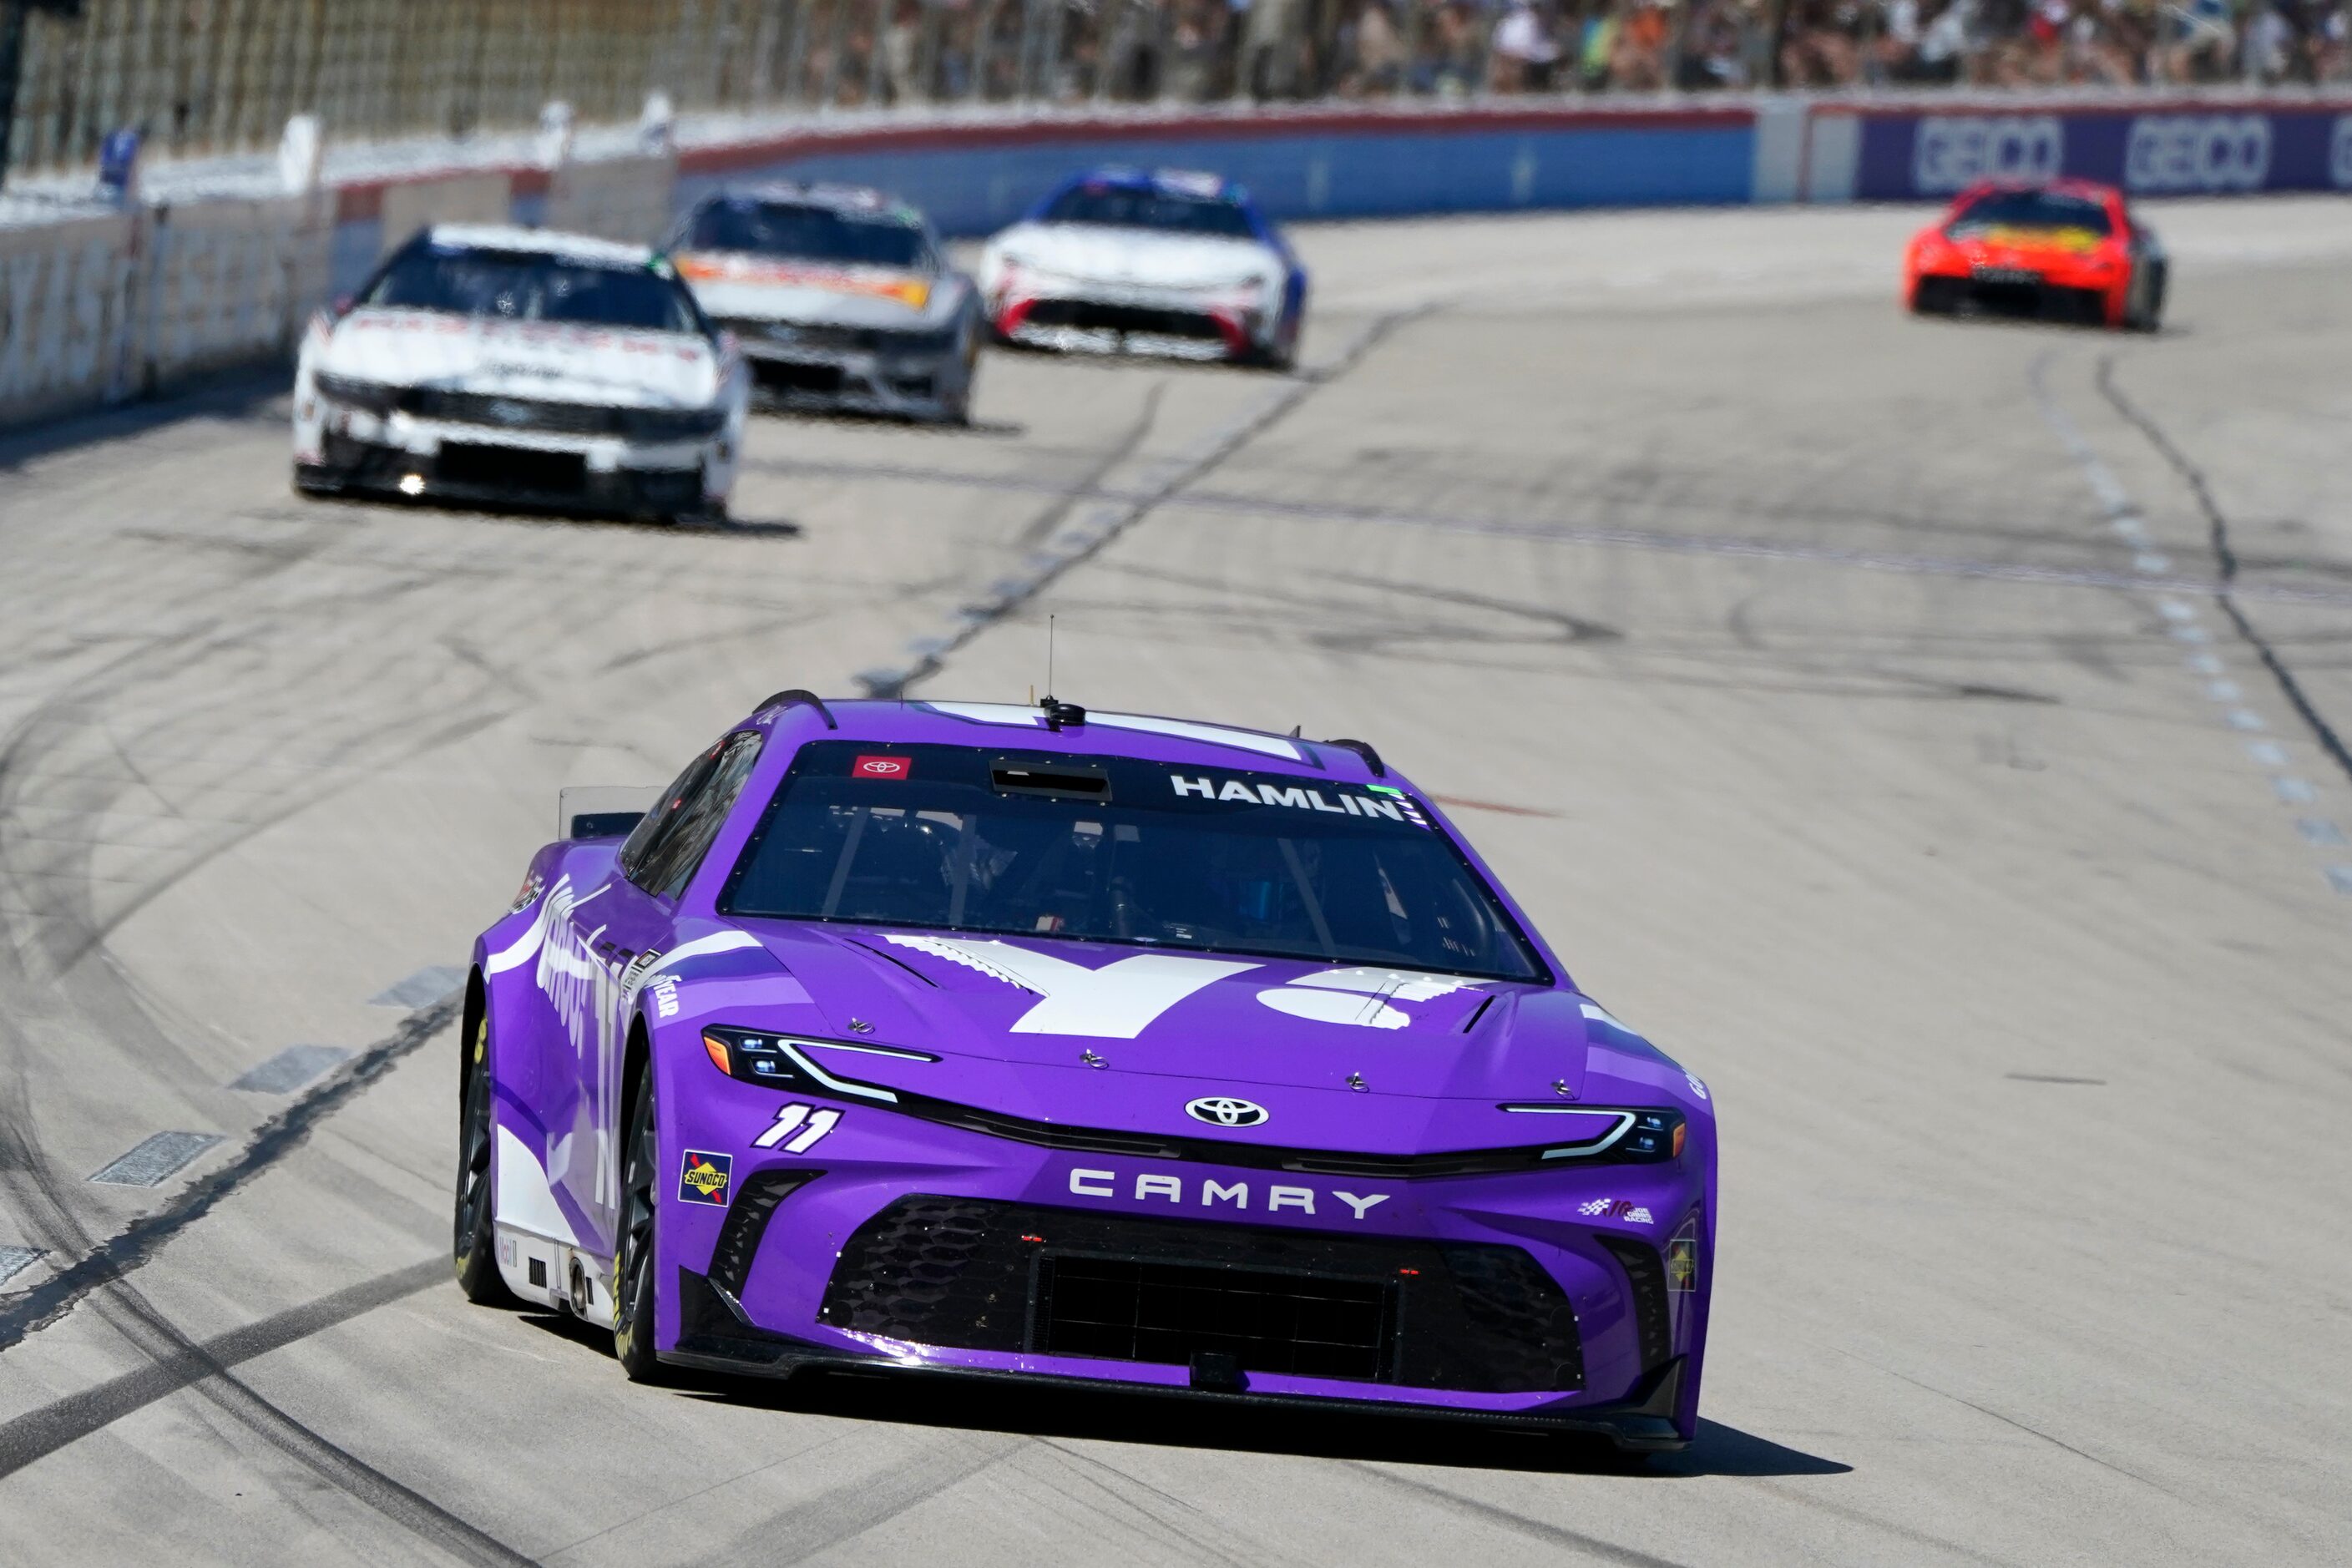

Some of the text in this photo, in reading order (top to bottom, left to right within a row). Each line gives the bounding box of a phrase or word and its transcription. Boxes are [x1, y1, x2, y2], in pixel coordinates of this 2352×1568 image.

[1913, 115, 2065, 191] GEICO
[2127, 114, 2272, 189] GEICO
[1171, 775, 1405, 822] HAMLIN
[749, 1100, 846, 1156] 11
[686, 1171, 726, 1186] SUNOCO
[1070, 1168, 1390, 1219] CAMRY
